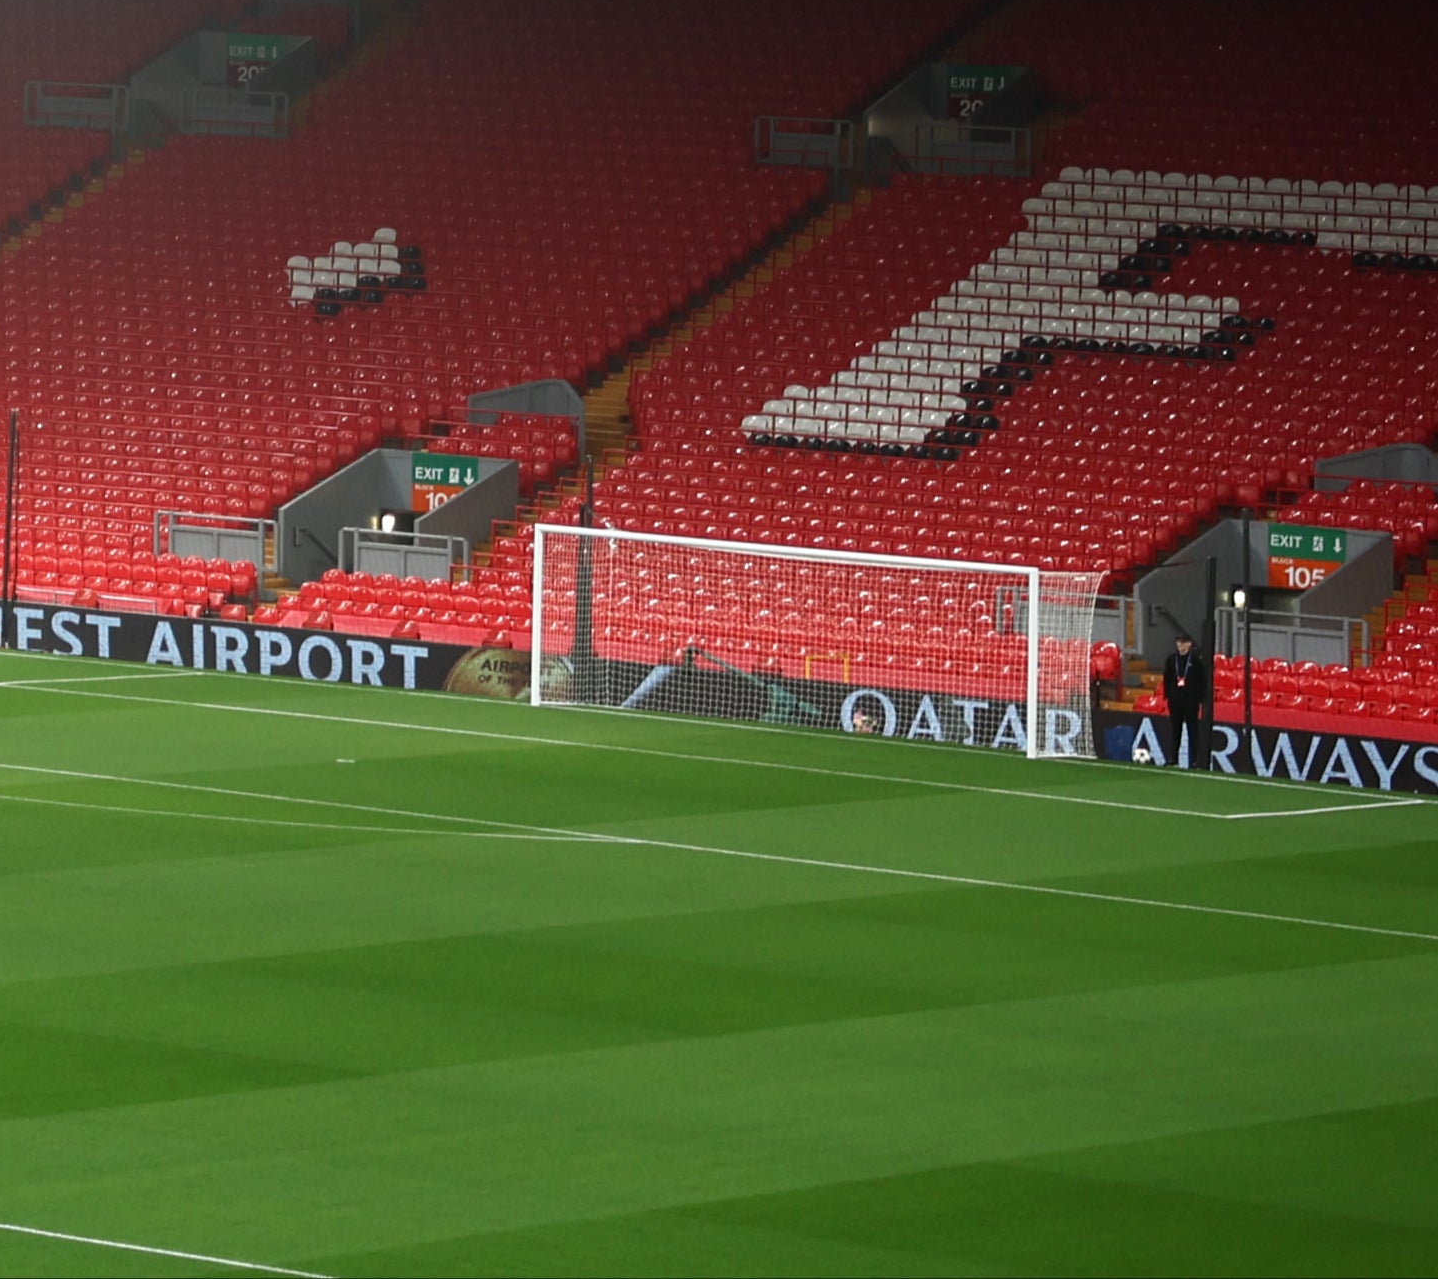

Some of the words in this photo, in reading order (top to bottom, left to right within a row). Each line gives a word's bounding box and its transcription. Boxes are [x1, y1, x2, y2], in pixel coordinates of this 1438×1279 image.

[228, 45, 254, 58] EXIT
[237, 66, 265, 83] 20
[951, 76, 978, 88] EXIT
[413, 466, 442, 482] EXIT
[424, 491, 455, 512] 10
[1269, 534, 1301, 549] EXIT
[1283, 567, 1323, 589] 105
[146, 619, 430, 691] AIRPORT
[1131, 716, 1438, 793] AIRWAYS
